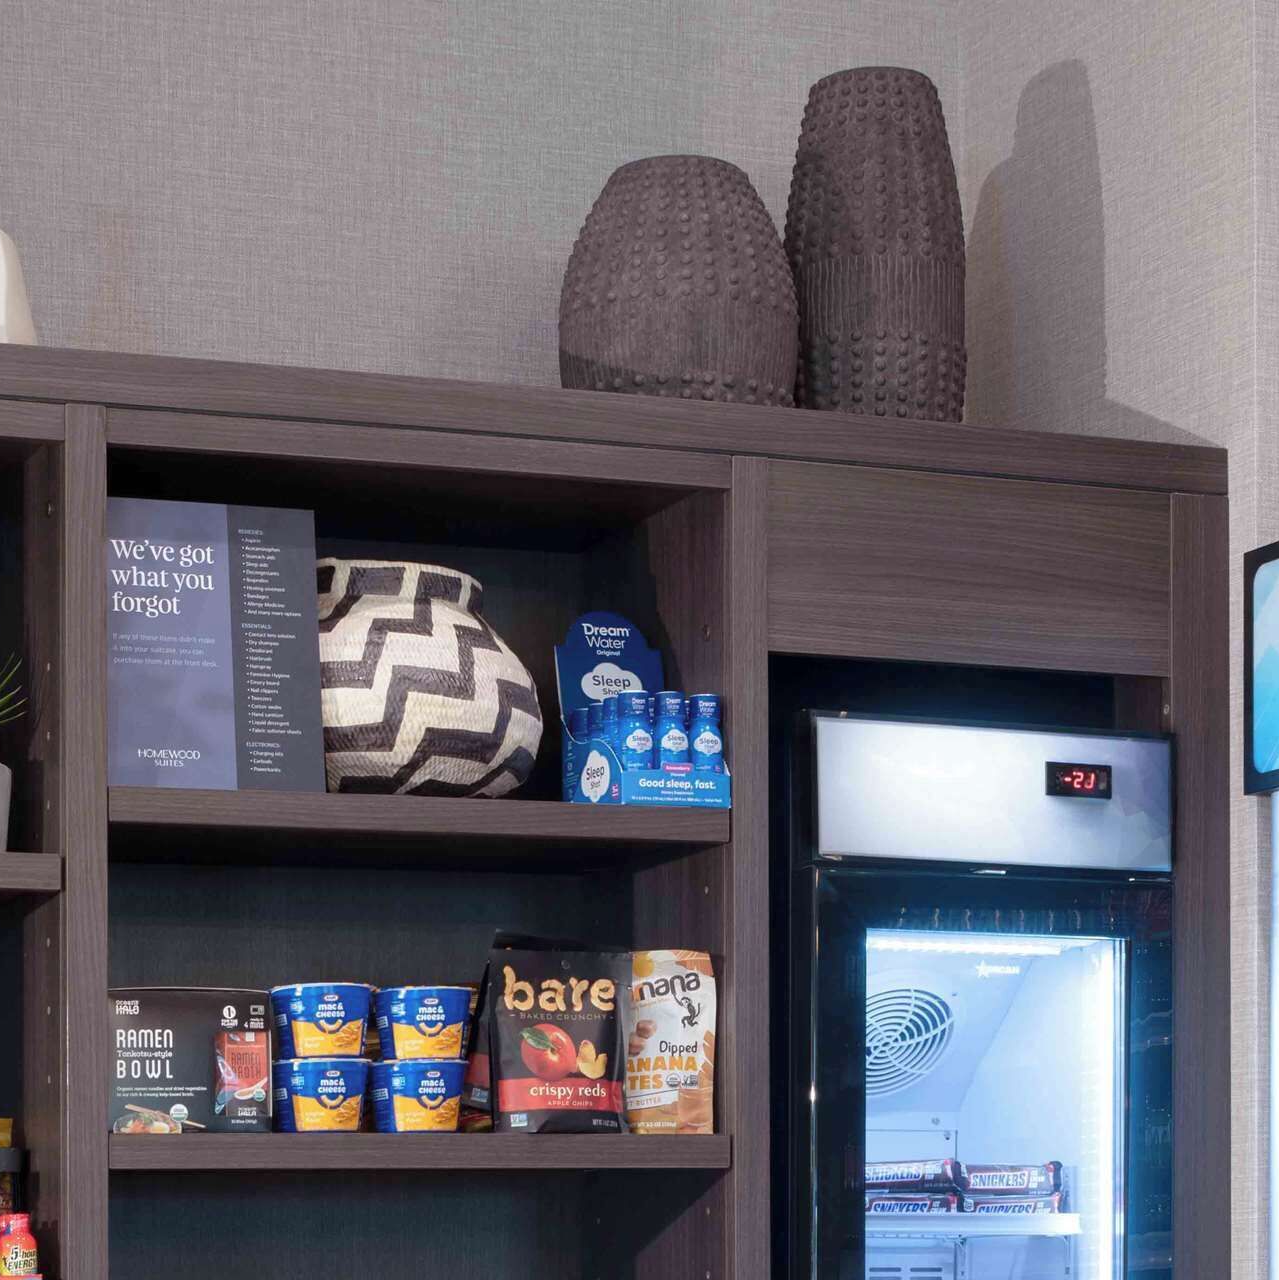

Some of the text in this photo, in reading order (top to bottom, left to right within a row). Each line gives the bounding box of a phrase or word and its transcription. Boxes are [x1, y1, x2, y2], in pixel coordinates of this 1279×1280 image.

[111, 539, 215, 566] We've got
[112, 567, 215, 592] what you
[112, 593, 181, 618] forgot
[582, 623, 629, 636] Dream
[586, 636, 625, 649] Water
[592, 676, 631, 689] Sleep
[603, 688, 620, 696] Sho
[667, 735, 685, 743] Sleep
[138, 748, 200, 760] HOMEWOOD
[154, 759, 184, 767] SUITES
[586, 765, 604, 781] Sleep
[639, 778, 716, 790] Good sleep, fast.
[503, 966, 616, 1011] bare
[116, 1029, 173, 1048] RAMEN
[660, 1041, 697, 1056] Dipped
[117, 1060, 173, 1079] BOWL
[627, 1056, 697, 1072] ANANA
[628, 1073, 664, 1090] TES
[530, 1084, 606, 1100] crispy reds
[971, 1173, 1027, 1187] SNICKERS
